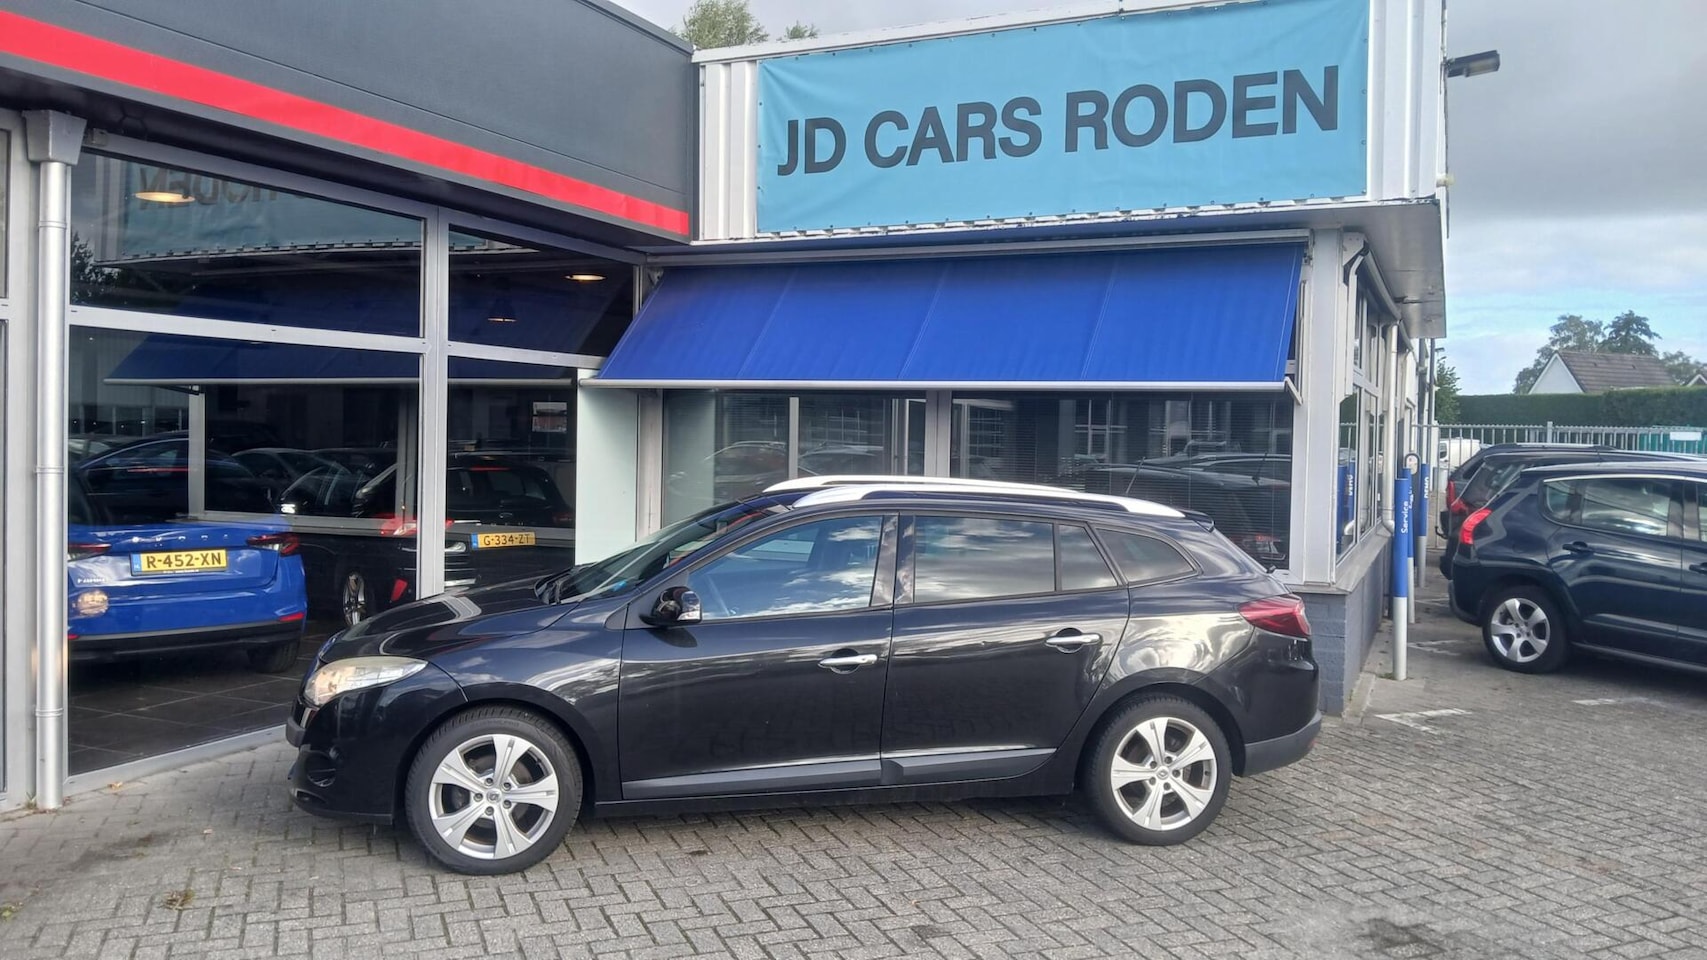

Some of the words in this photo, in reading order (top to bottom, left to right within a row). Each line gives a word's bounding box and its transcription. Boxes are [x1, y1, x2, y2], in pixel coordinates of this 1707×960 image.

[778, 117, 847, 176] JD
[864, 96, 1043, 169] CARS
[1065, 65, 1339, 152] RODEN
[1401, 501, 1409, 534] Service
[483, 533, 530, 546] G-334-ZT
[146, 552, 222, 569] R-452-XN
